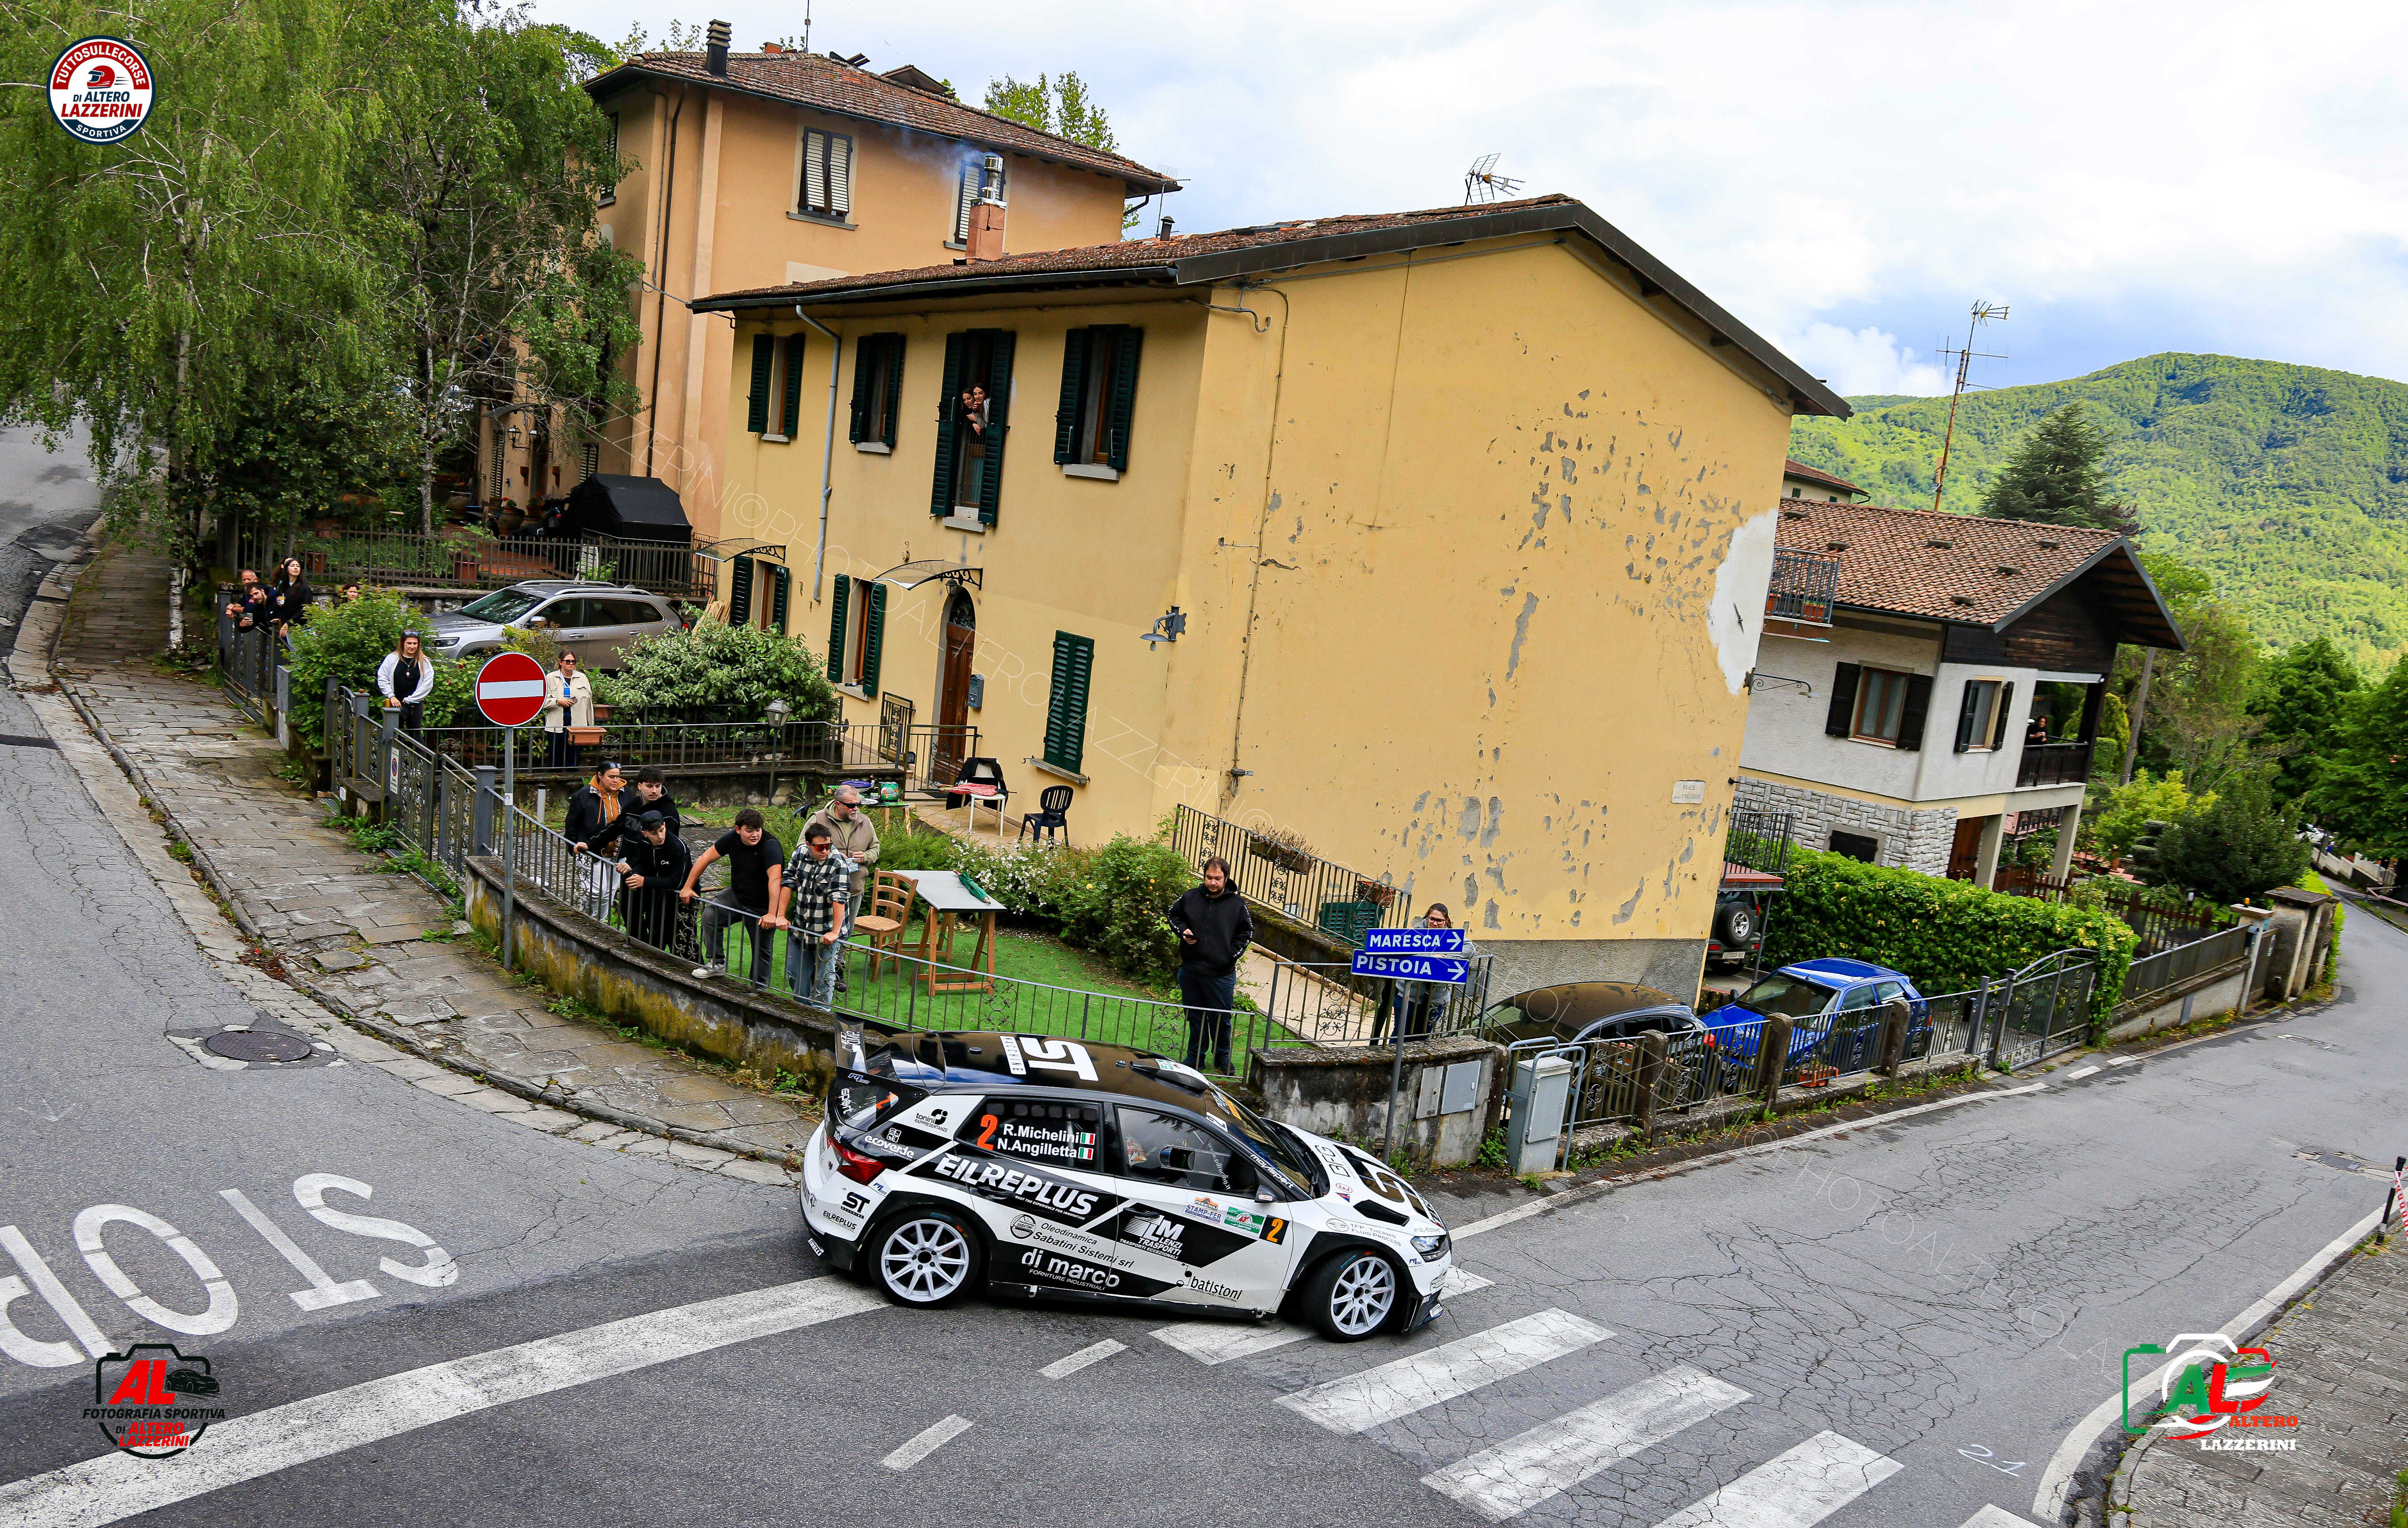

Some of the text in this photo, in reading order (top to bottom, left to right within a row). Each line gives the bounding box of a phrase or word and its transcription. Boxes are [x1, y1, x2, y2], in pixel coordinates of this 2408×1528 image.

[1370, 935, 1440, 947] MARESCA
[1356, 956, 1431, 975] PISTOIA
[1003, 1037, 1023, 1071] MACCHINE
[914, 1119, 948, 1132] RAPPRESENTANZE
[916, 1112, 935, 1124] tonini
[977, 1114, 998, 1151] 2
[1003, 1124, 1080, 1143] R.Michelini
[864, 1135, 914, 1158] ecoverde
[997, 1138, 1077, 1158] N.Angilletta
[934, 1152, 1099, 1215] EILREPLUS
[842, 1191, 871, 1213] ST
[1032, 1201, 1055, 1211] EXPERIENCE
[1063, 1211, 1085, 1220] INNOVATION
[1186, 1204, 1222, 1220] STAMP-FER
[822, 1211, 857, 1230] EILREPLUS
[1267, 1218, 1283, 1243] 2
[1041, 1223, 1098, 1245] Oleodinamica
[1159, 1237, 1183, 1248] LENZI
[1369, 1228, 1396, 1239] THERMO
[1373, 1233, 1401, 1246] PROCESS
[1033, 1232, 1134, 1269] Sabatini Sistemi srl
[1119, 1239, 1178, 1260] TRASPORTI ECCEZIONALI
[1138, 1237, 1182, 1256] TRASPORTI
[0, 1173, 458, 1367] STOP
[1021, 1248, 1120, 1287] di marco
[1029, 1269, 1105, 1290] FORNITURE INDUSTRIALI
